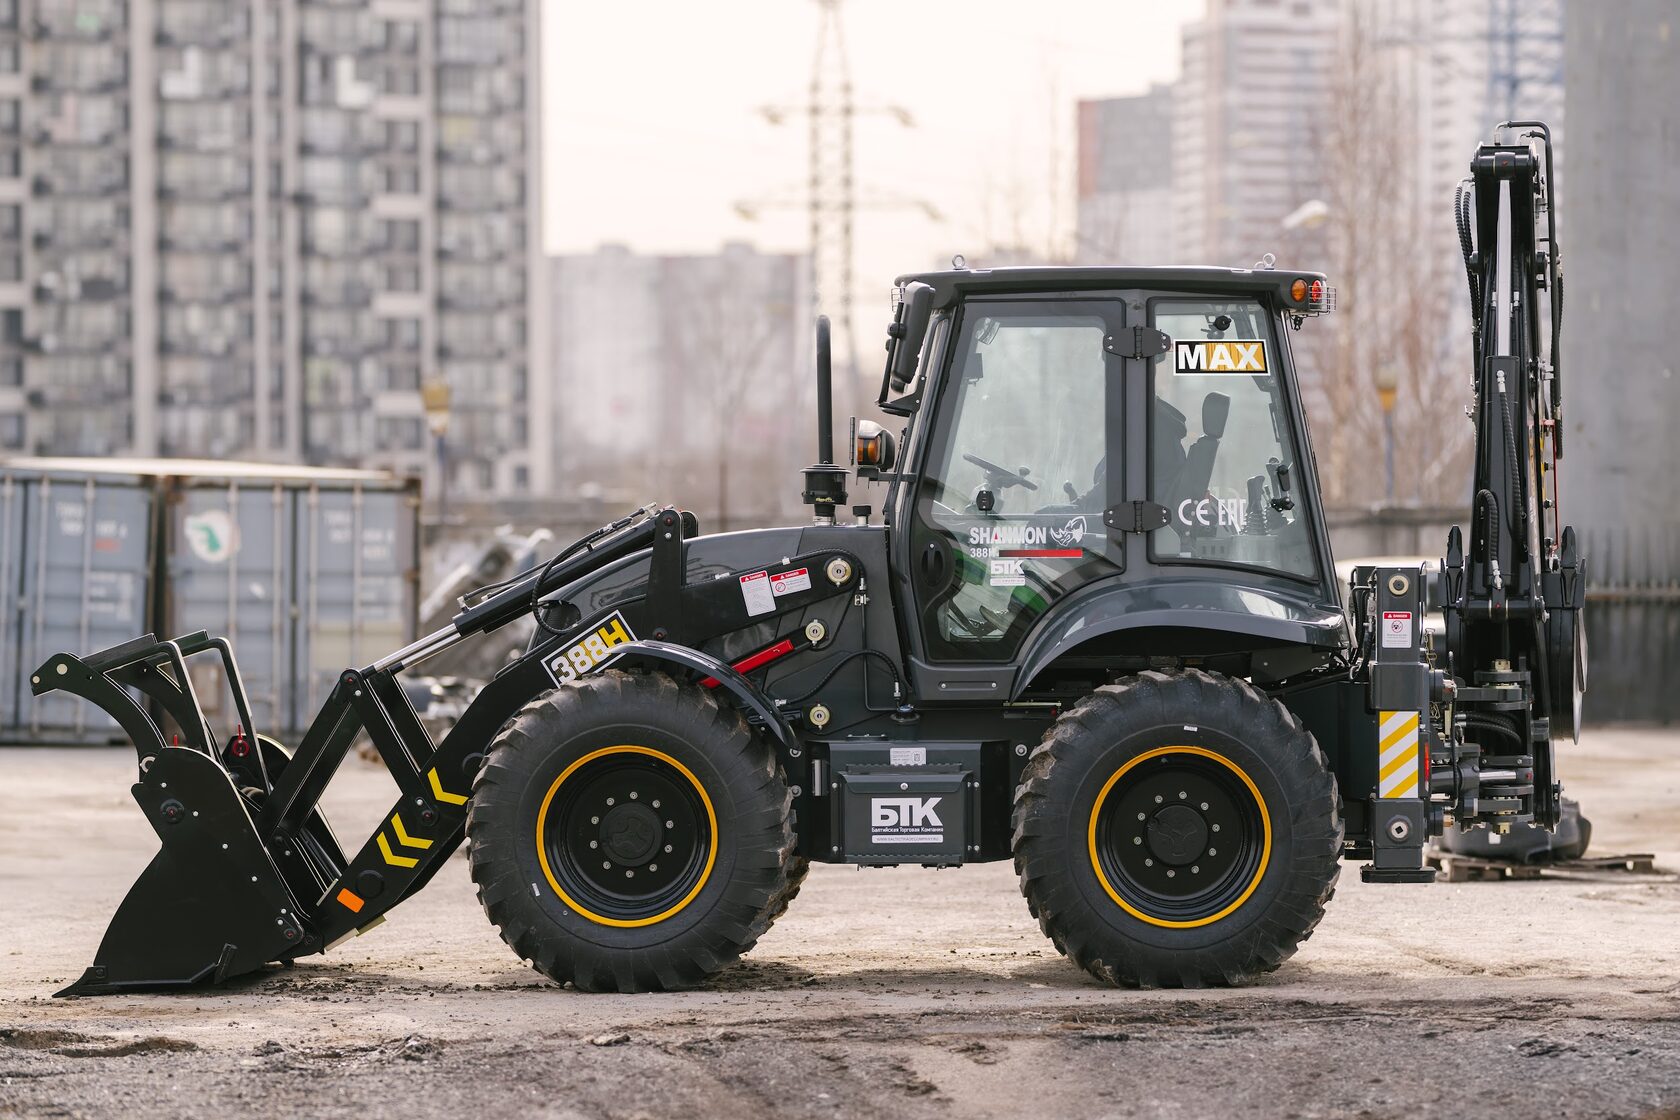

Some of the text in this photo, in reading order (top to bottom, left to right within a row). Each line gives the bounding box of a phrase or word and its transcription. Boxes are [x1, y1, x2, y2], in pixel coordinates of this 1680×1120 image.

[1178, 344, 1263, 370] MAX
[1178, 499, 1210, 526] CE
[990, 560, 1025, 574] БТК
[551, 619, 631, 684] 388H
[872, 797, 943, 827] БТК
